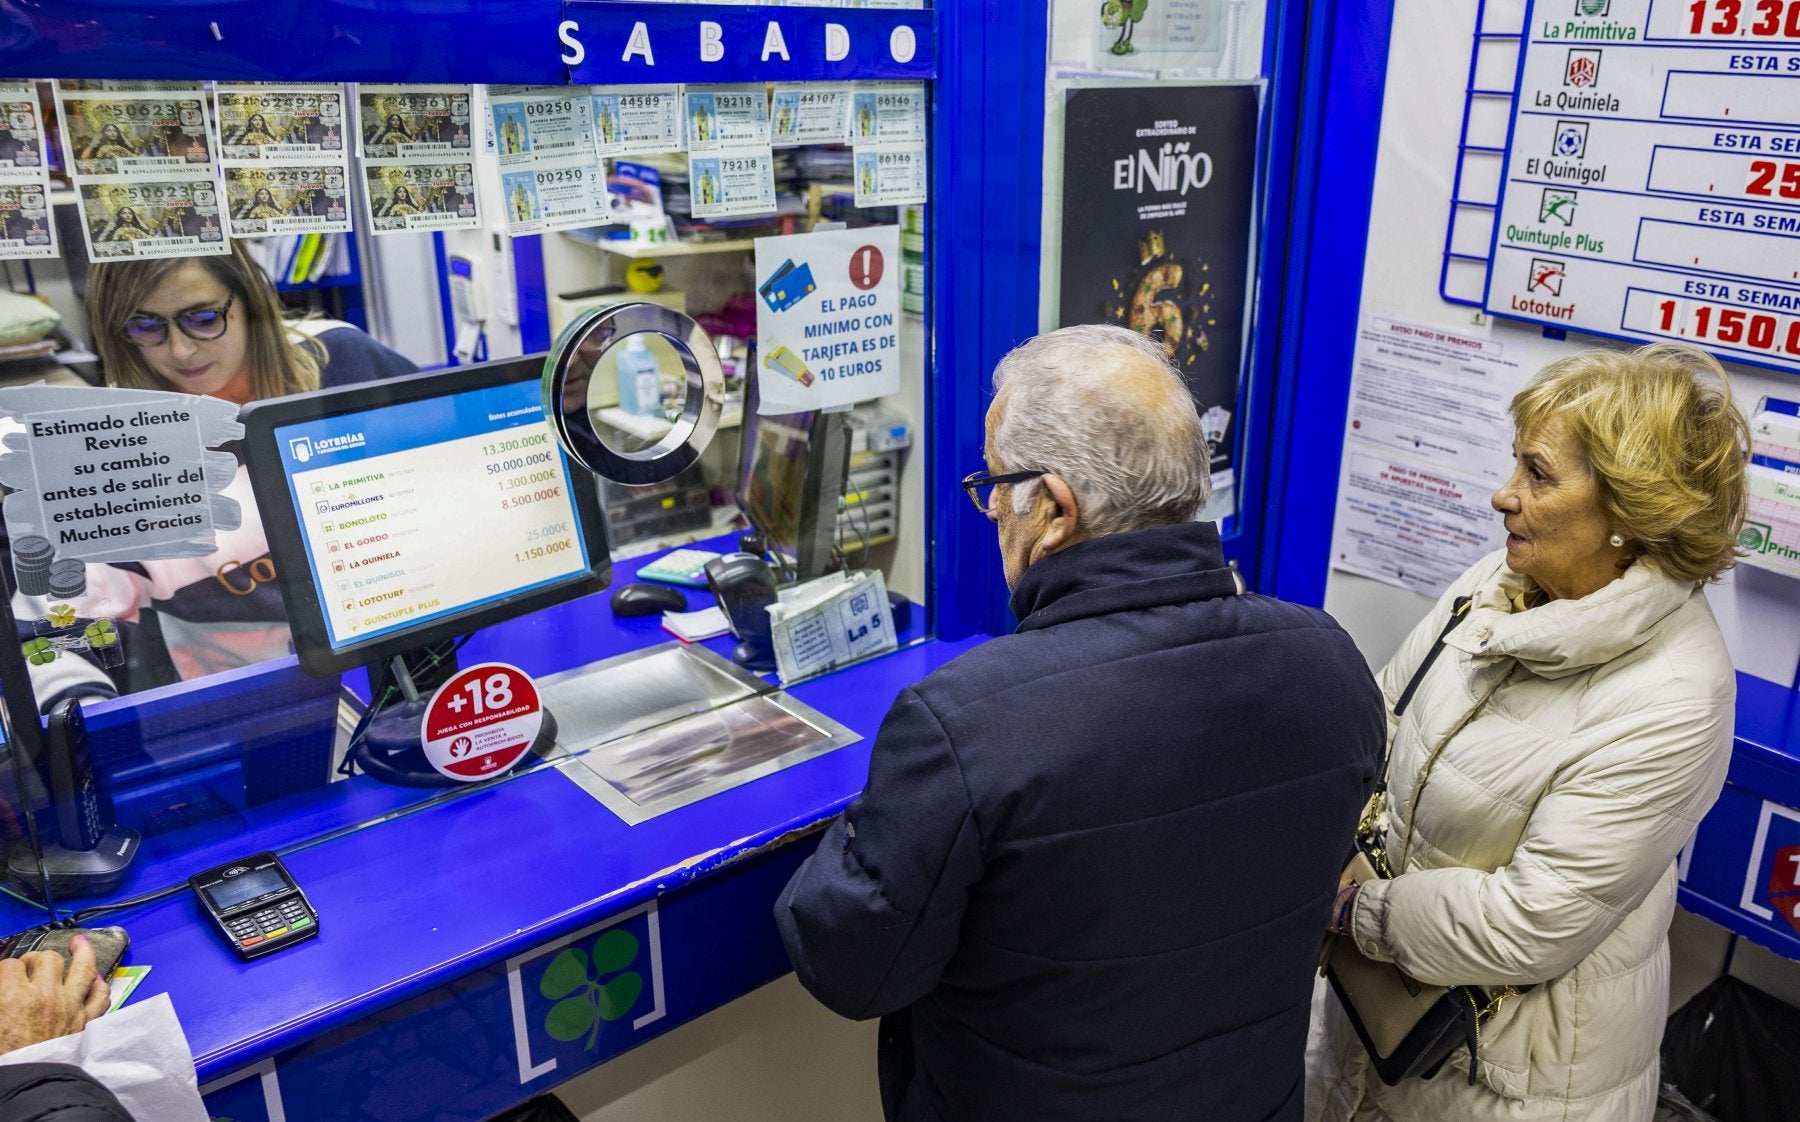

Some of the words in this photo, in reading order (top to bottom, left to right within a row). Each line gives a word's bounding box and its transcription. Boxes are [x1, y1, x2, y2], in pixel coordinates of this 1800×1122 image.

[1543, 22, 1560, 39] La
[1564, 21, 1637, 41] Primitiva
[557, 20, 916, 66] SABADO
[1729, 55, 1779, 71] ESTA
[261, 97, 317, 108] 62492
[398, 97, 450, 108] 49361
[527, 101, 572, 115] 00250
[620, 96, 660, 107] 44589
[716, 97, 752, 108] 79218
[801, 94, 836, 104] 44107
[878, 97, 910, 106] 86146
[1535, 90, 1552, 107] La
[1556, 91, 1620, 112] Quiniela
[113, 103, 176, 118] 50623
[1713, 133, 1762, 150] ESTA
[722, 160, 757, 170] 79218
[879, 155, 911, 164] 86146
[1136, 141, 1213, 196] Niño
[267, 171, 321, 181] 62492
[404, 168, 453, 178] 49361
[537, 169, 583, 184] 00250
[1526, 158, 1538, 175] El
[1543, 160, 1607, 185] Quinigol
[128, 186, 189, 199] 50623
[1698, 208, 1745, 226] ESTA
[1575, 234, 1604, 254] Plus
[1684, 280, 1730, 299] ESTA
[821, 300, 836, 313] EL
[840, 293, 877, 311] PAGO
[1510, 295, 1575, 320] Lototurf
[804, 318, 860, 339] MINIMO
[864, 313, 893, 329] CON
[802, 342, 859, 362] TARJETA
[862, 338, 876, 351] ES
[880, 335, 896, 348] DE
[820, 368, 836, 382] 10
[839, 359, 883, 378] EUROS
[506, 405, 542, 418] acumulados
[32, 415, 125, 438] Estimado
[130, 409, 190, 429] cliente
[85, 433, 148, 452] Revise
[314, 432, 365, 450] LOTERÍAS
[483, 433, 549, 456] 13.300.000€
[74, 462, 95, 476] su
[101, 451, 171, 472] cambio
[486, 451, 552, 475] 50.000.000€
[43, 484, 97, 502] antes
[102, 478, 127, 495] de
[131, 472, 172, 490] salir
[177, 467, 204, 485] del
[329, 482, 340, 491] LA
[342, 473, 385, 488] PRIMITIVA
[498, 468, 557, 491] 1.300.000€
[331, 495, 384, 512] EUROMILLONES
[502, 486, 561, 510] 8.500.000€
[53, 493, 202, 523] establecimiento
[60, 524, 131, 544] Muchas
[135, 513, 202, 533] Gracias
[339, 513, 387, 530] BONOLOTO
[527, 521, 568, 541] 25.000€
[344, 542, 355, 550] EL
[356, 533, 389, 546] GORDO
[349, 561, 360, 569] LA
[362, 551, 401, 566] QUINIELA
[515, 539, 573, 564] 1.150.000€
[353, 580, 365, 588] EL
[365, 568, 406, 585] QUINIGOL
[359, 588, 405, 607] LOTOTURF
[364, 606, 414, 626] QUINTUPLE
[417, 599, 441, 611] PLUS
[848, 625, 869, 643] La
[871, 613, 881, 629] 5
[447, 673, 513, 715] +18
[436, 725, 458, 736] JUEGA
[458, 718, 473, 729] CON
[474, 705, 530, 724] RESPONSABILIDAD
